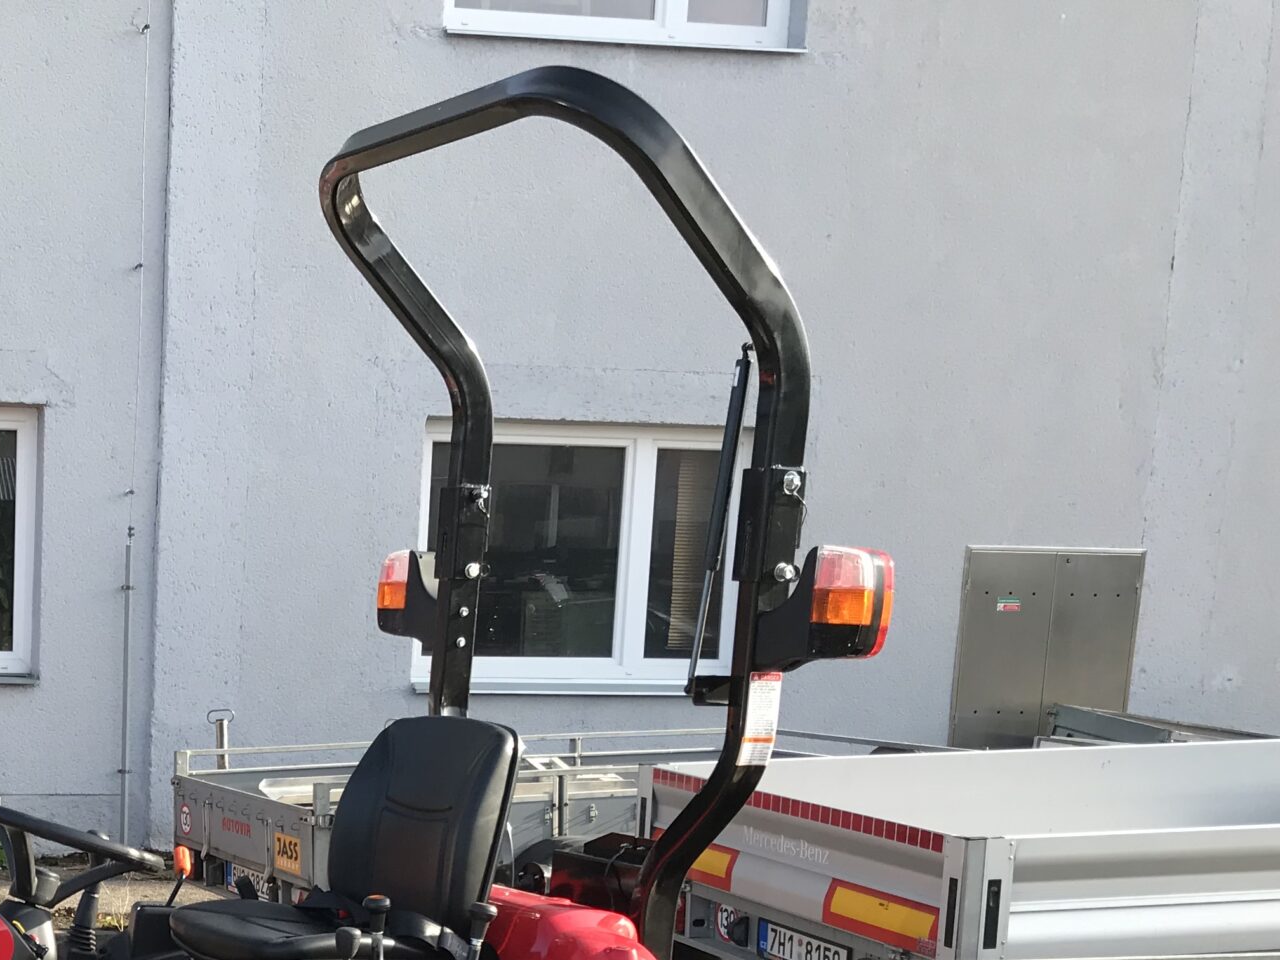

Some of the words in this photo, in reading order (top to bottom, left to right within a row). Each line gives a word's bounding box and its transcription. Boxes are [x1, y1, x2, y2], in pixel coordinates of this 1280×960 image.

[222, 816, 251, 839] AUTOVIA
[276, 836, 299, 862] JASS
[742, 825, 830, 865] Mercedes-Benz
[770, 927, 794, 960] 7H1
